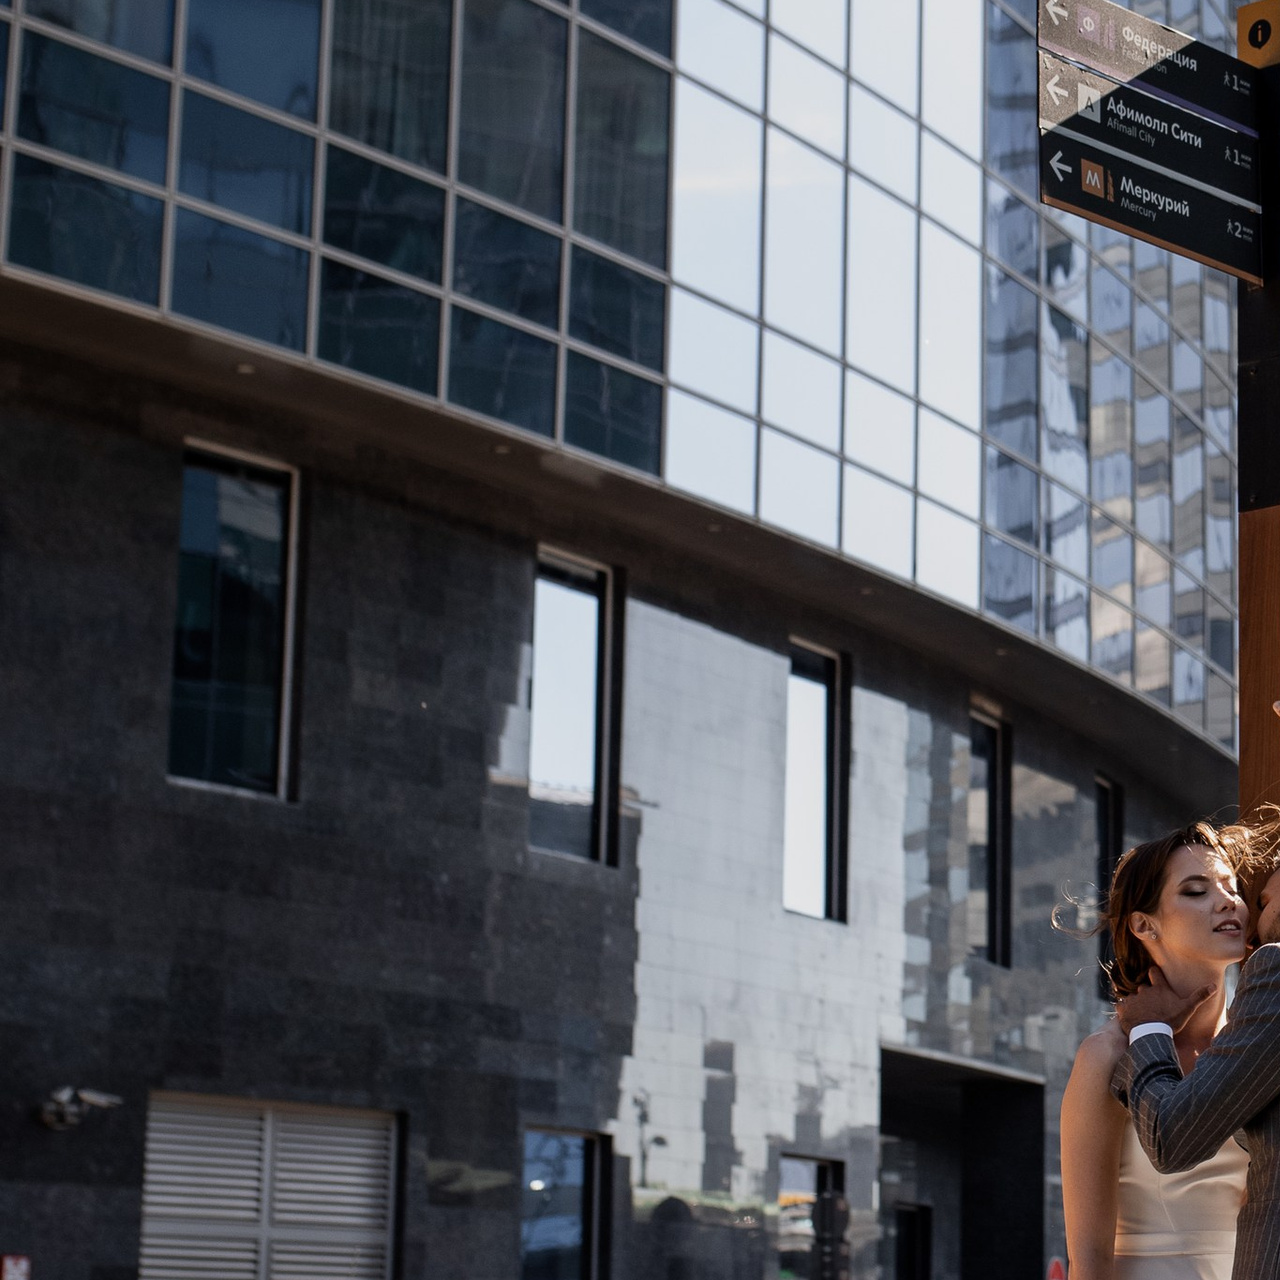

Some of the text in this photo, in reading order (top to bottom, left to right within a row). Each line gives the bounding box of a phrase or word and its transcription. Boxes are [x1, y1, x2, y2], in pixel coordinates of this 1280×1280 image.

[1122, 26, 1197, 71] Федерация
[1232, 75, 1239, 91] 1
[1107, 96, 1202, 148] Афимолл Сити
[1107, 117, 1156, 147] Afimall City
[1233, 149, 1240, 165] 1
[1120, 176, 1190, 217] Меркурий
[1121, 197, 1157, 221] Mercury
[1234, 222, 1242, 238] 2
